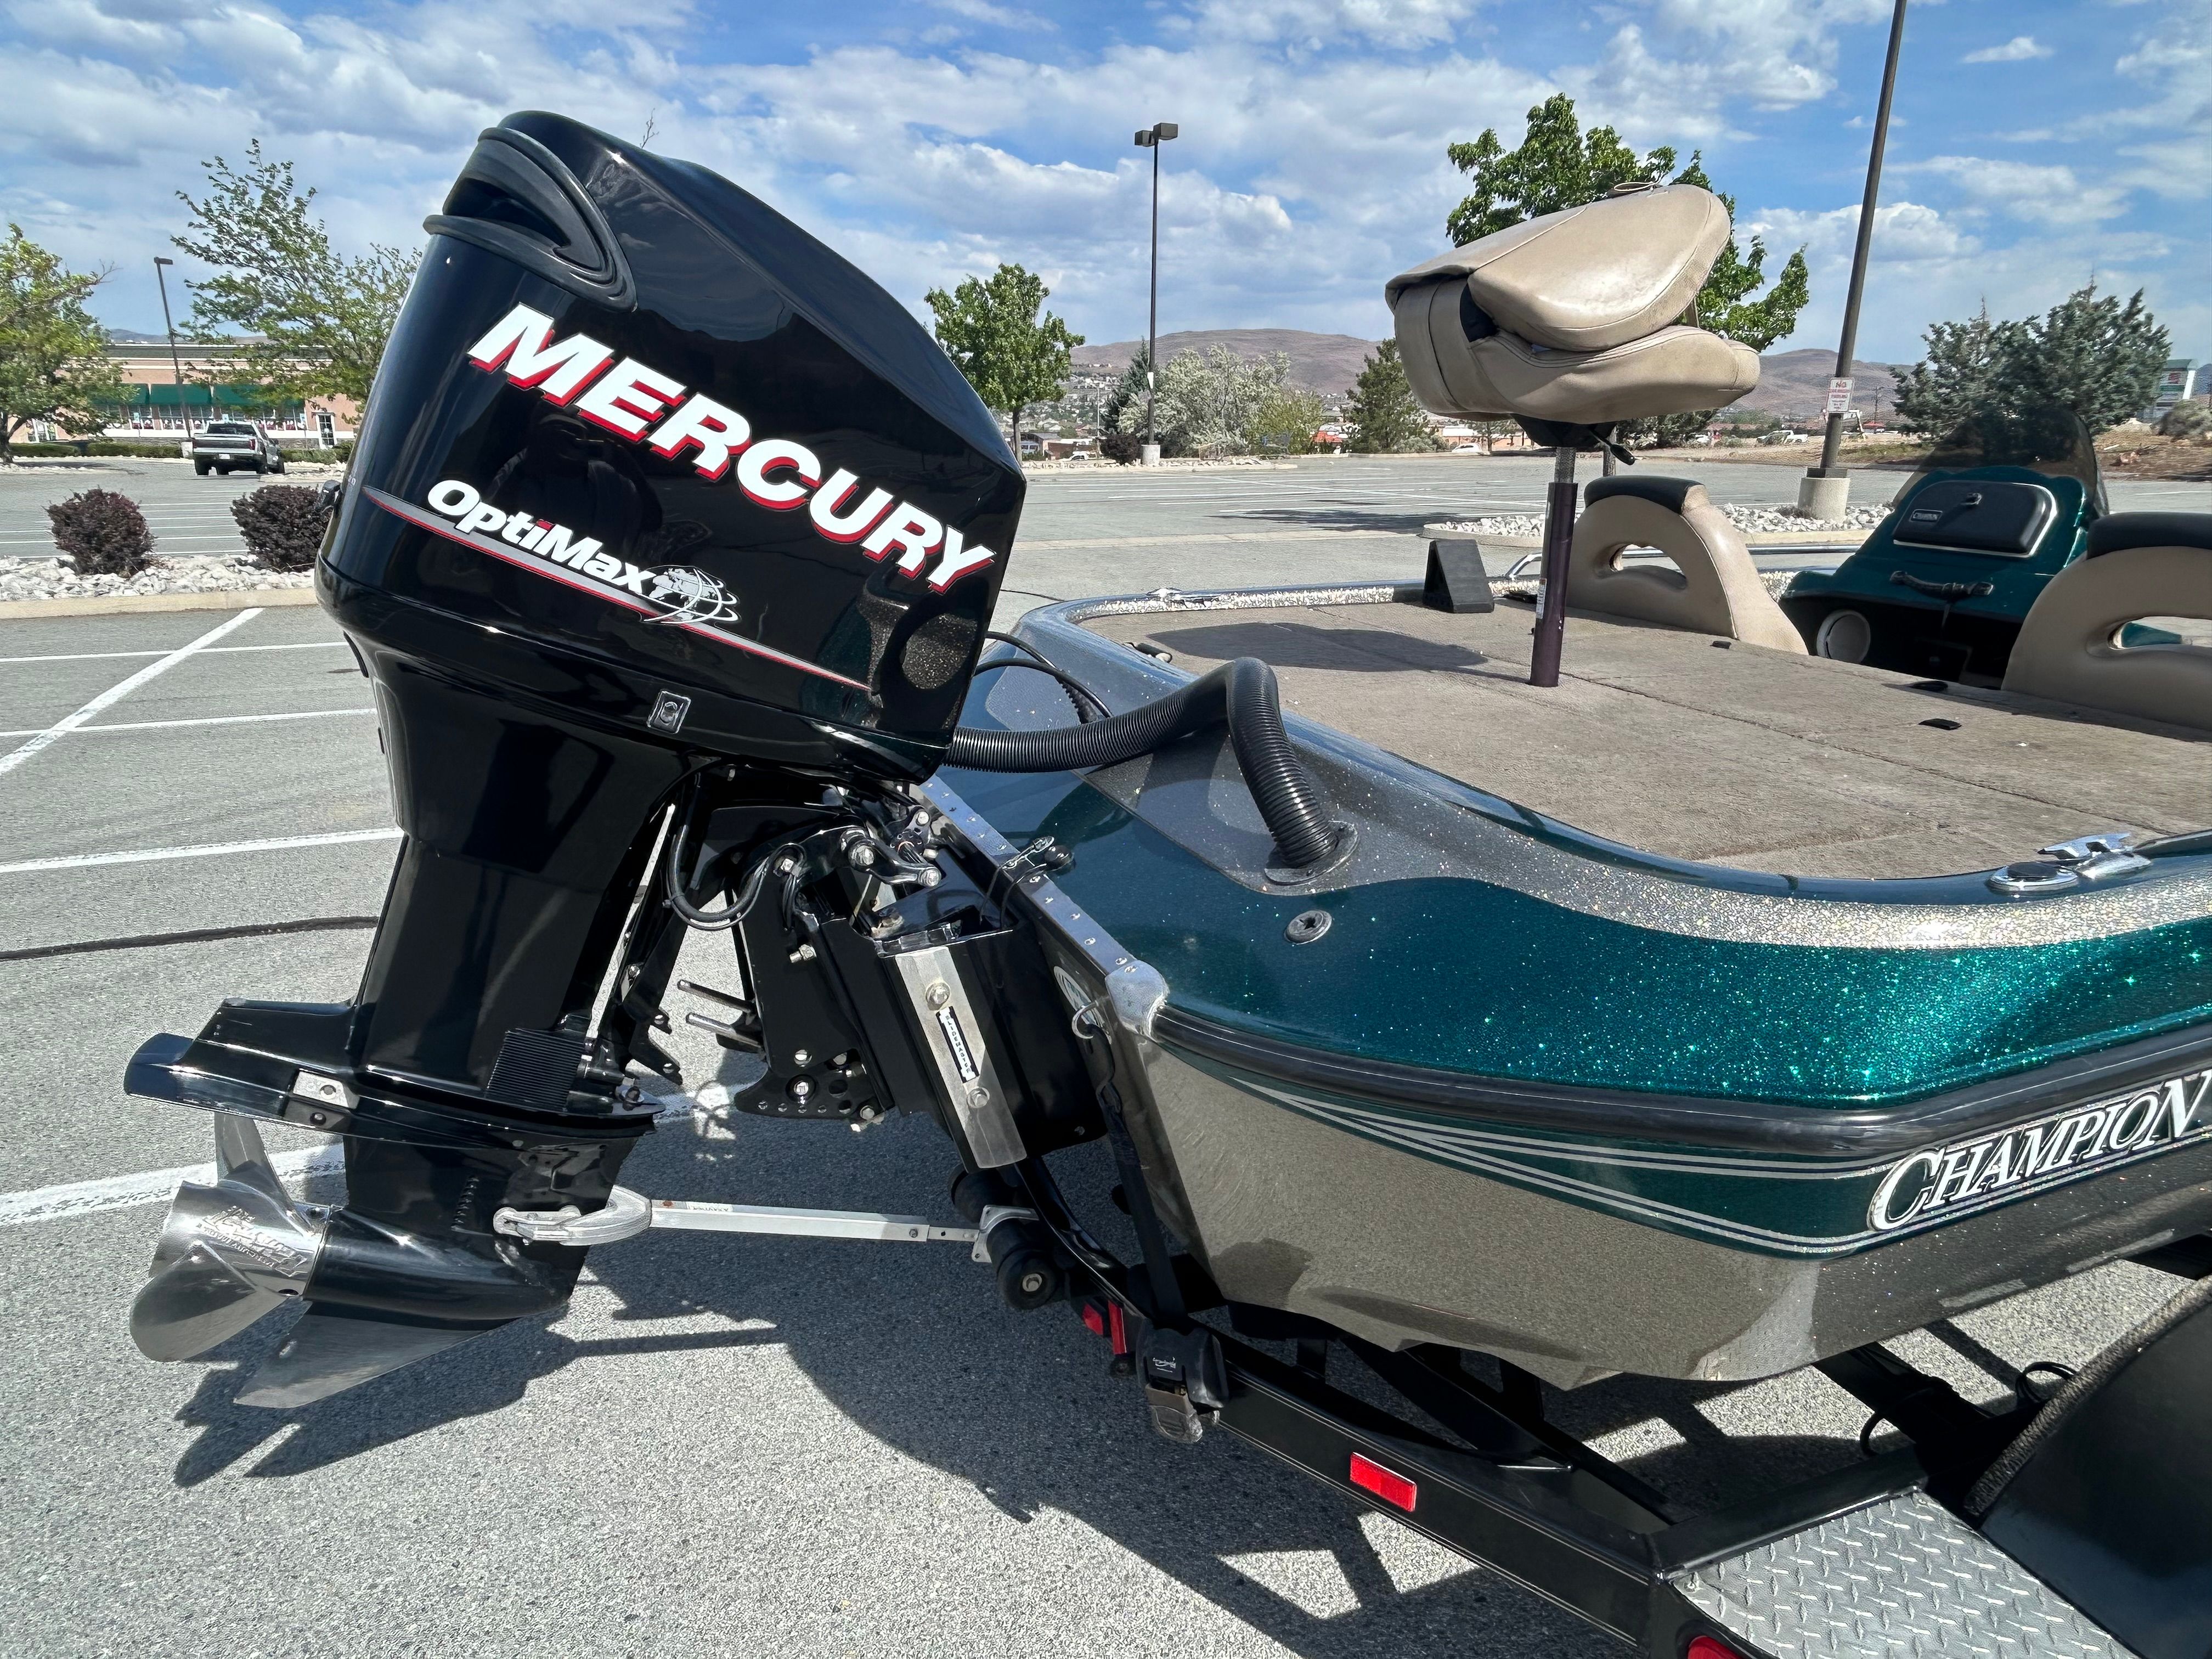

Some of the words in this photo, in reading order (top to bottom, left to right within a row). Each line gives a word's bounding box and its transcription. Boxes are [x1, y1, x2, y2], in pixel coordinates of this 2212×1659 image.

[467, 302, 995, 594] MERCURY
[427, 479, 657, 594] OptiMax
[1866, 1069, 2212, 1232] CHAMPION
